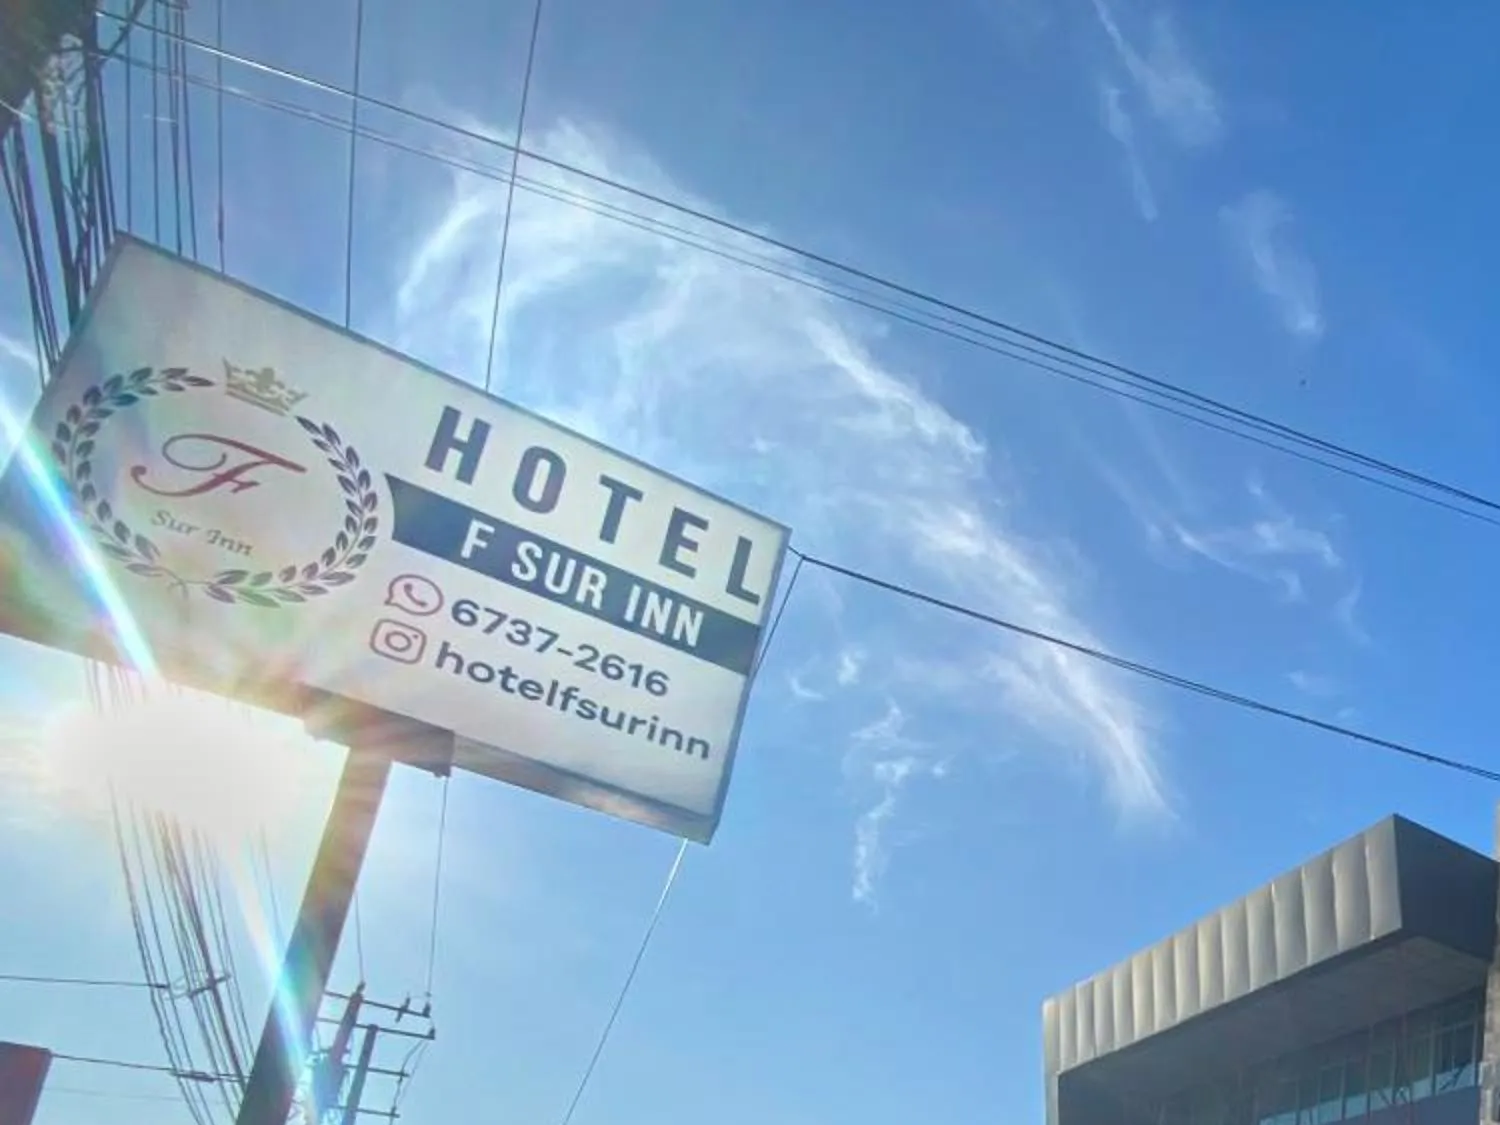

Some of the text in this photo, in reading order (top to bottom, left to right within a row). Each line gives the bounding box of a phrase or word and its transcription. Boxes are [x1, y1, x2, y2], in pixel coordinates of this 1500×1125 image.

[150, 509, 254, 556] Sur Inn
[424, 405, 760, 605] HOTEL
[460, 519, 704, 647] F SUR INN
[434, 641, 711, 760] hotelfsurinn
[451, 599, 671, 697] 6737-2616
